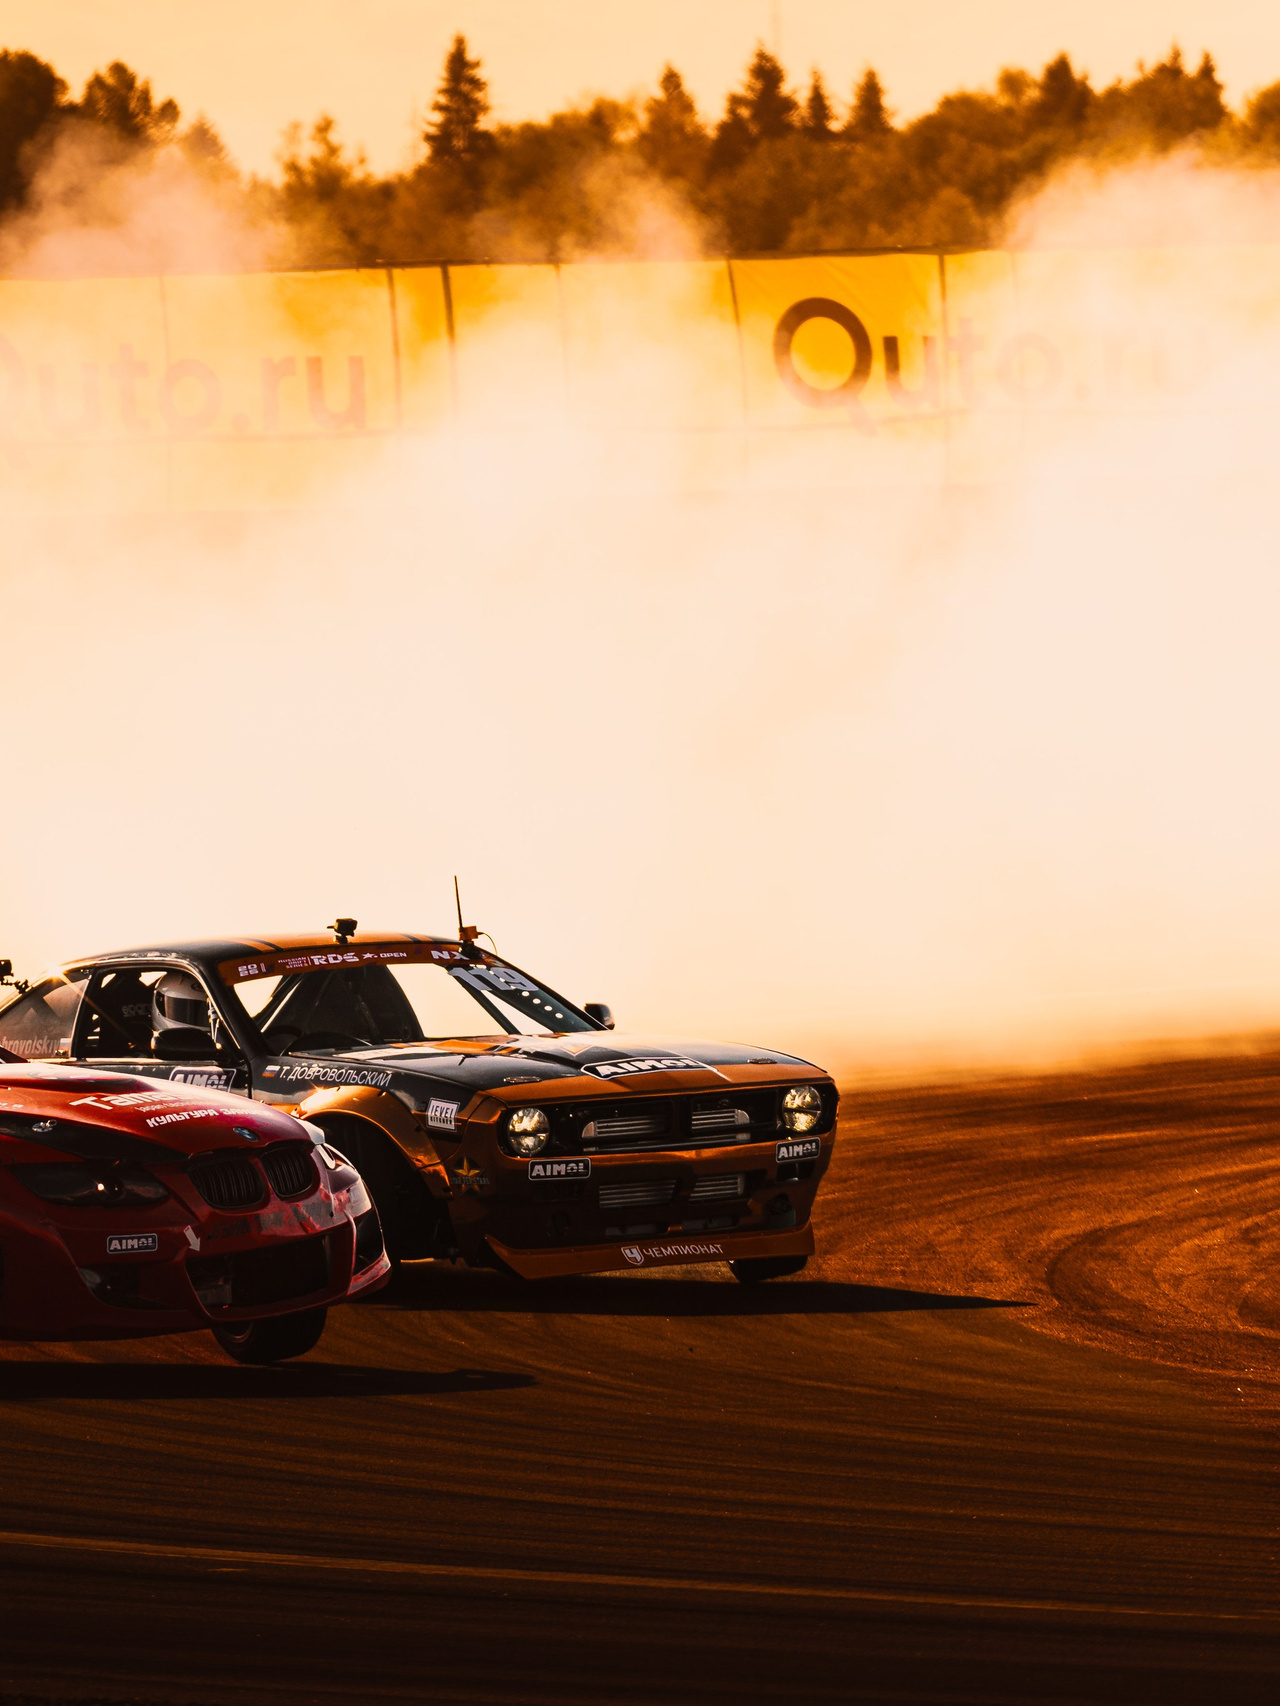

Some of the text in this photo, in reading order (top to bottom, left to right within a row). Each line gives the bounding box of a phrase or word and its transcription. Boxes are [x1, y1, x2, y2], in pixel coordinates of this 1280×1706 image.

[310, 952, 359, 965] RDS
[448, 967, 540, 991] 119
[287, 1065, 393, 1087] ДОБРОВОЛЬСКИЙ
[595, 1059, 700, 1077] AIMOL
[146, 1108, 219, 1128] КУЛЬТУРА
[778, 1142, 818, 1158] AIMOL
[531, 1163, 588, 1176] AIMOL
[110, 1237, 156, 1250] AIMOL
[643, 1244, 724, 1258] ЧЕМПИОНАТ
